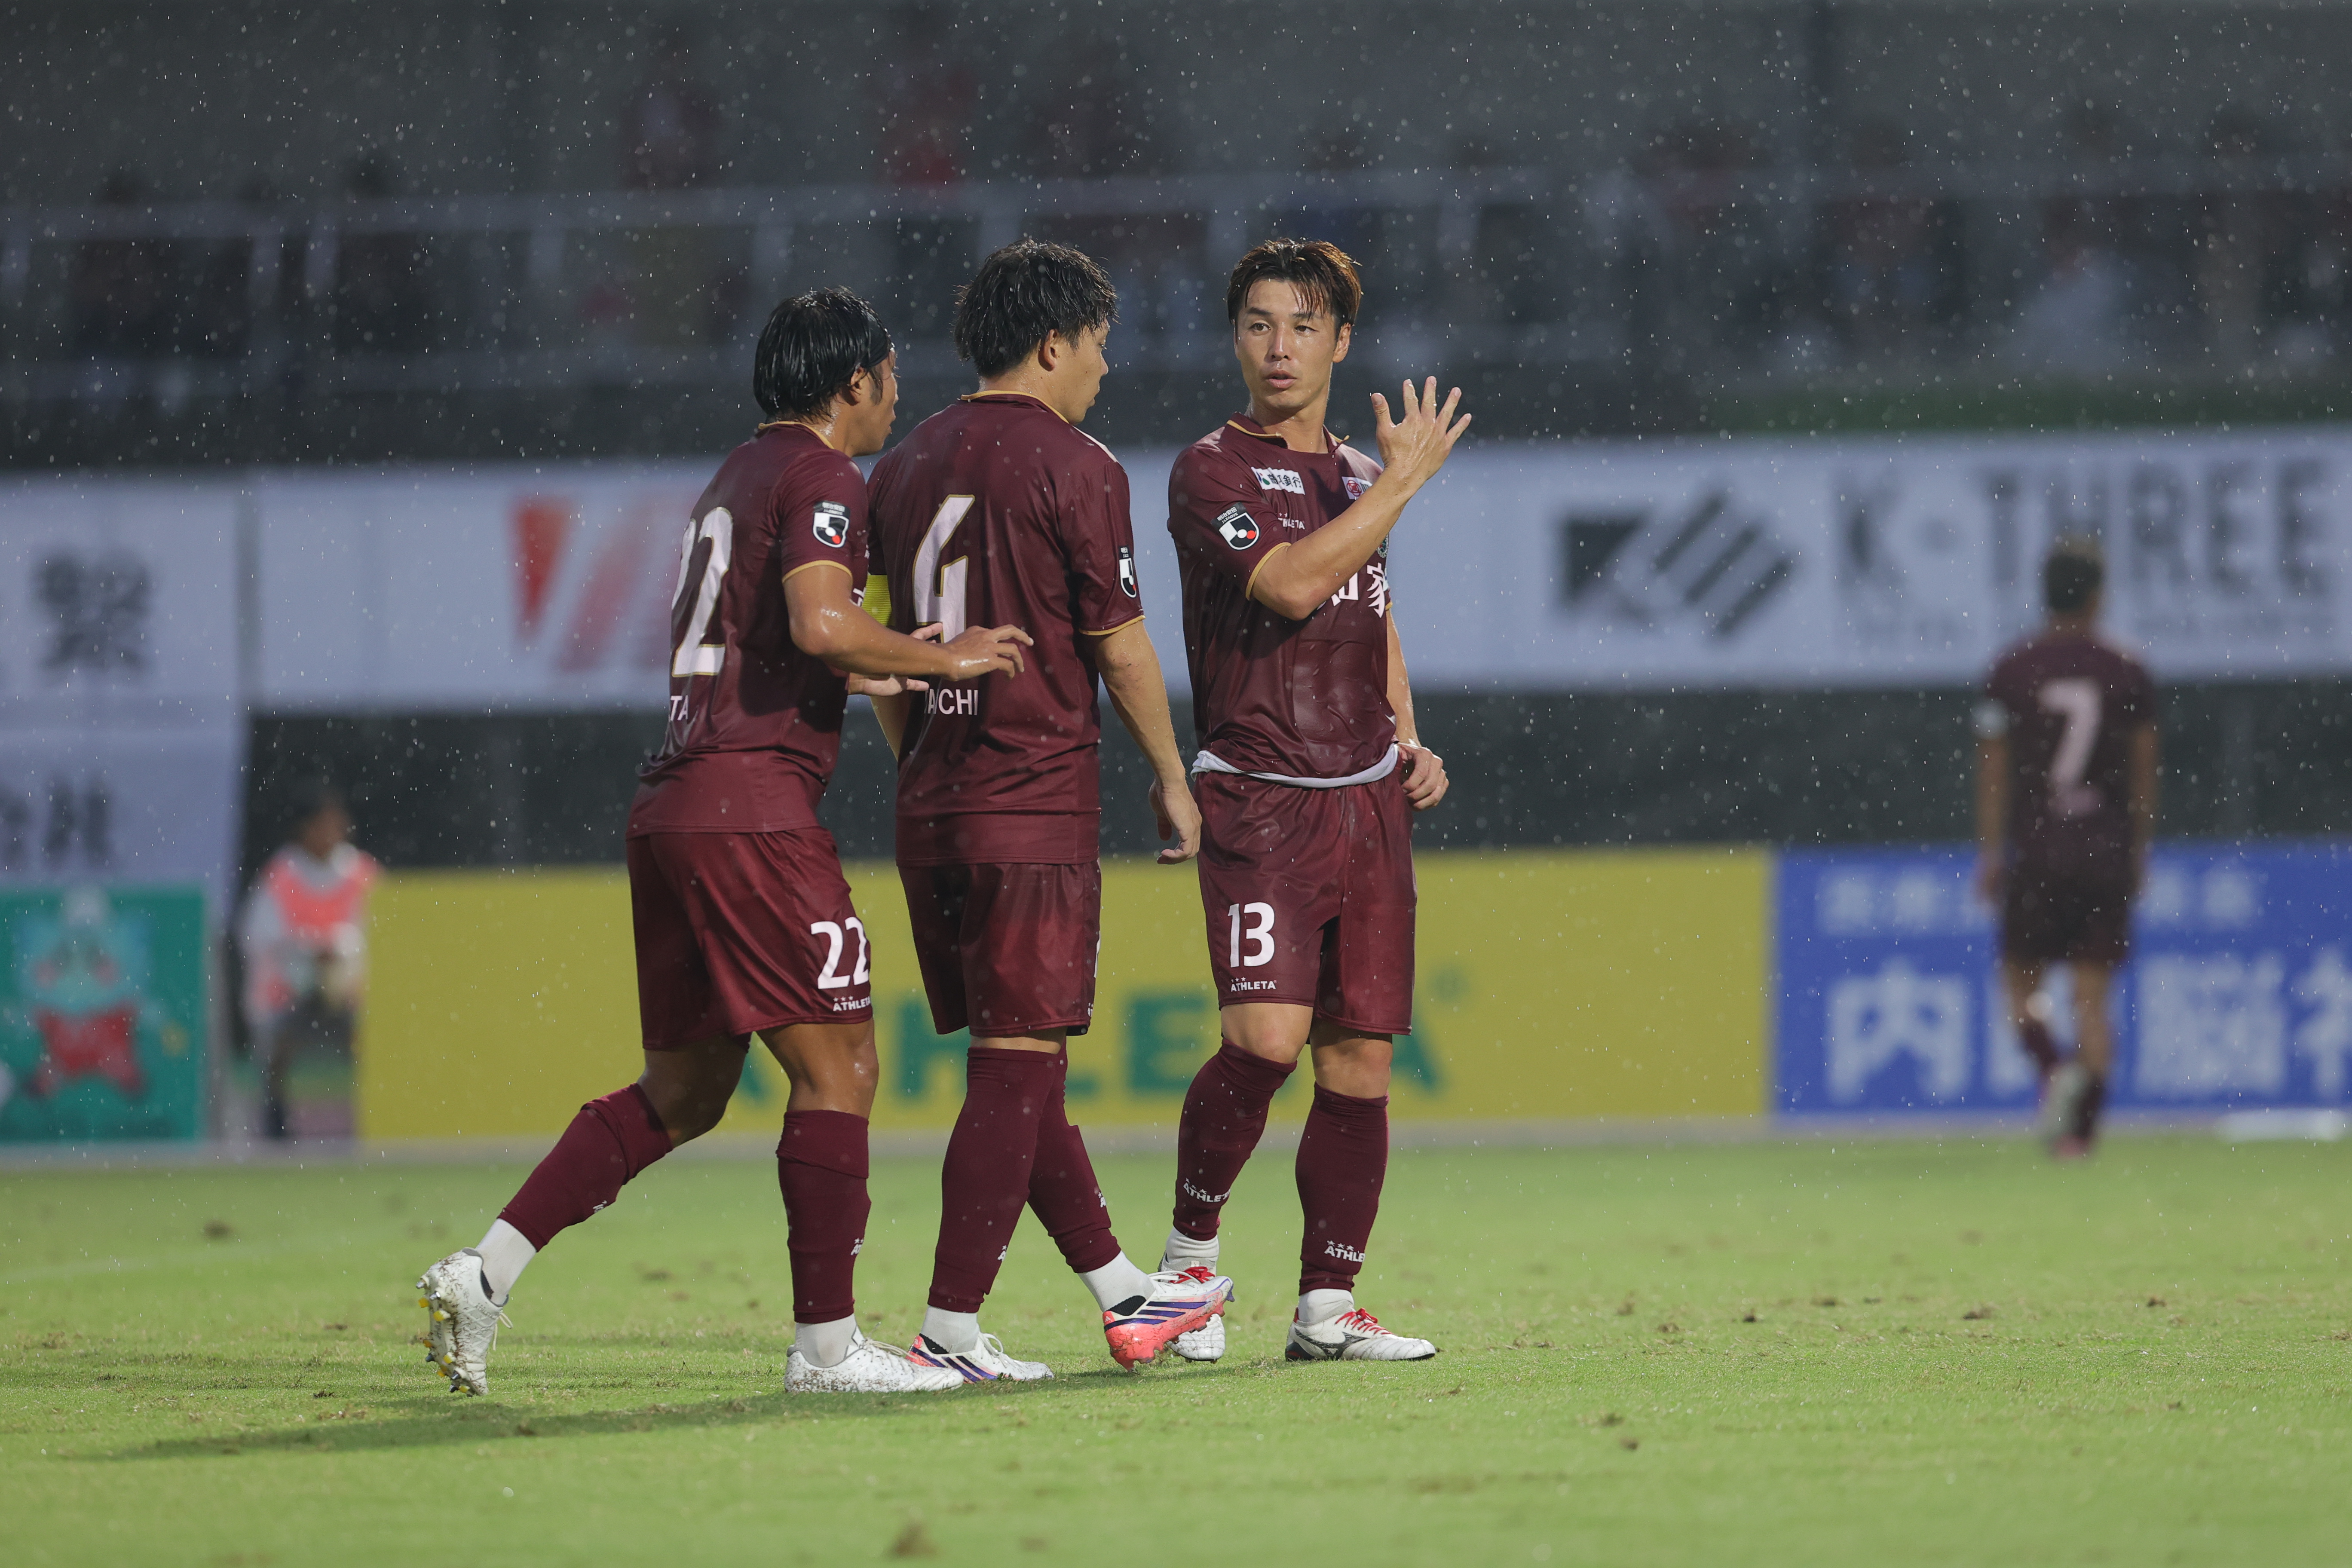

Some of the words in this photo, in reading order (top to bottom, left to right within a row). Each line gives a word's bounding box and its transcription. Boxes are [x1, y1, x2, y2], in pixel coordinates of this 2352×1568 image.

[1217, 507, 1237, 521] 明治安田
[925, 688, 978, 716] ACHI
[1228, 902, 1275, 968] 13
[811, 916, 869, 989] 22
[1231, 980, 1276, 992] ATHLETA
[1183, 1182, 1231, 1202] ATHLET
